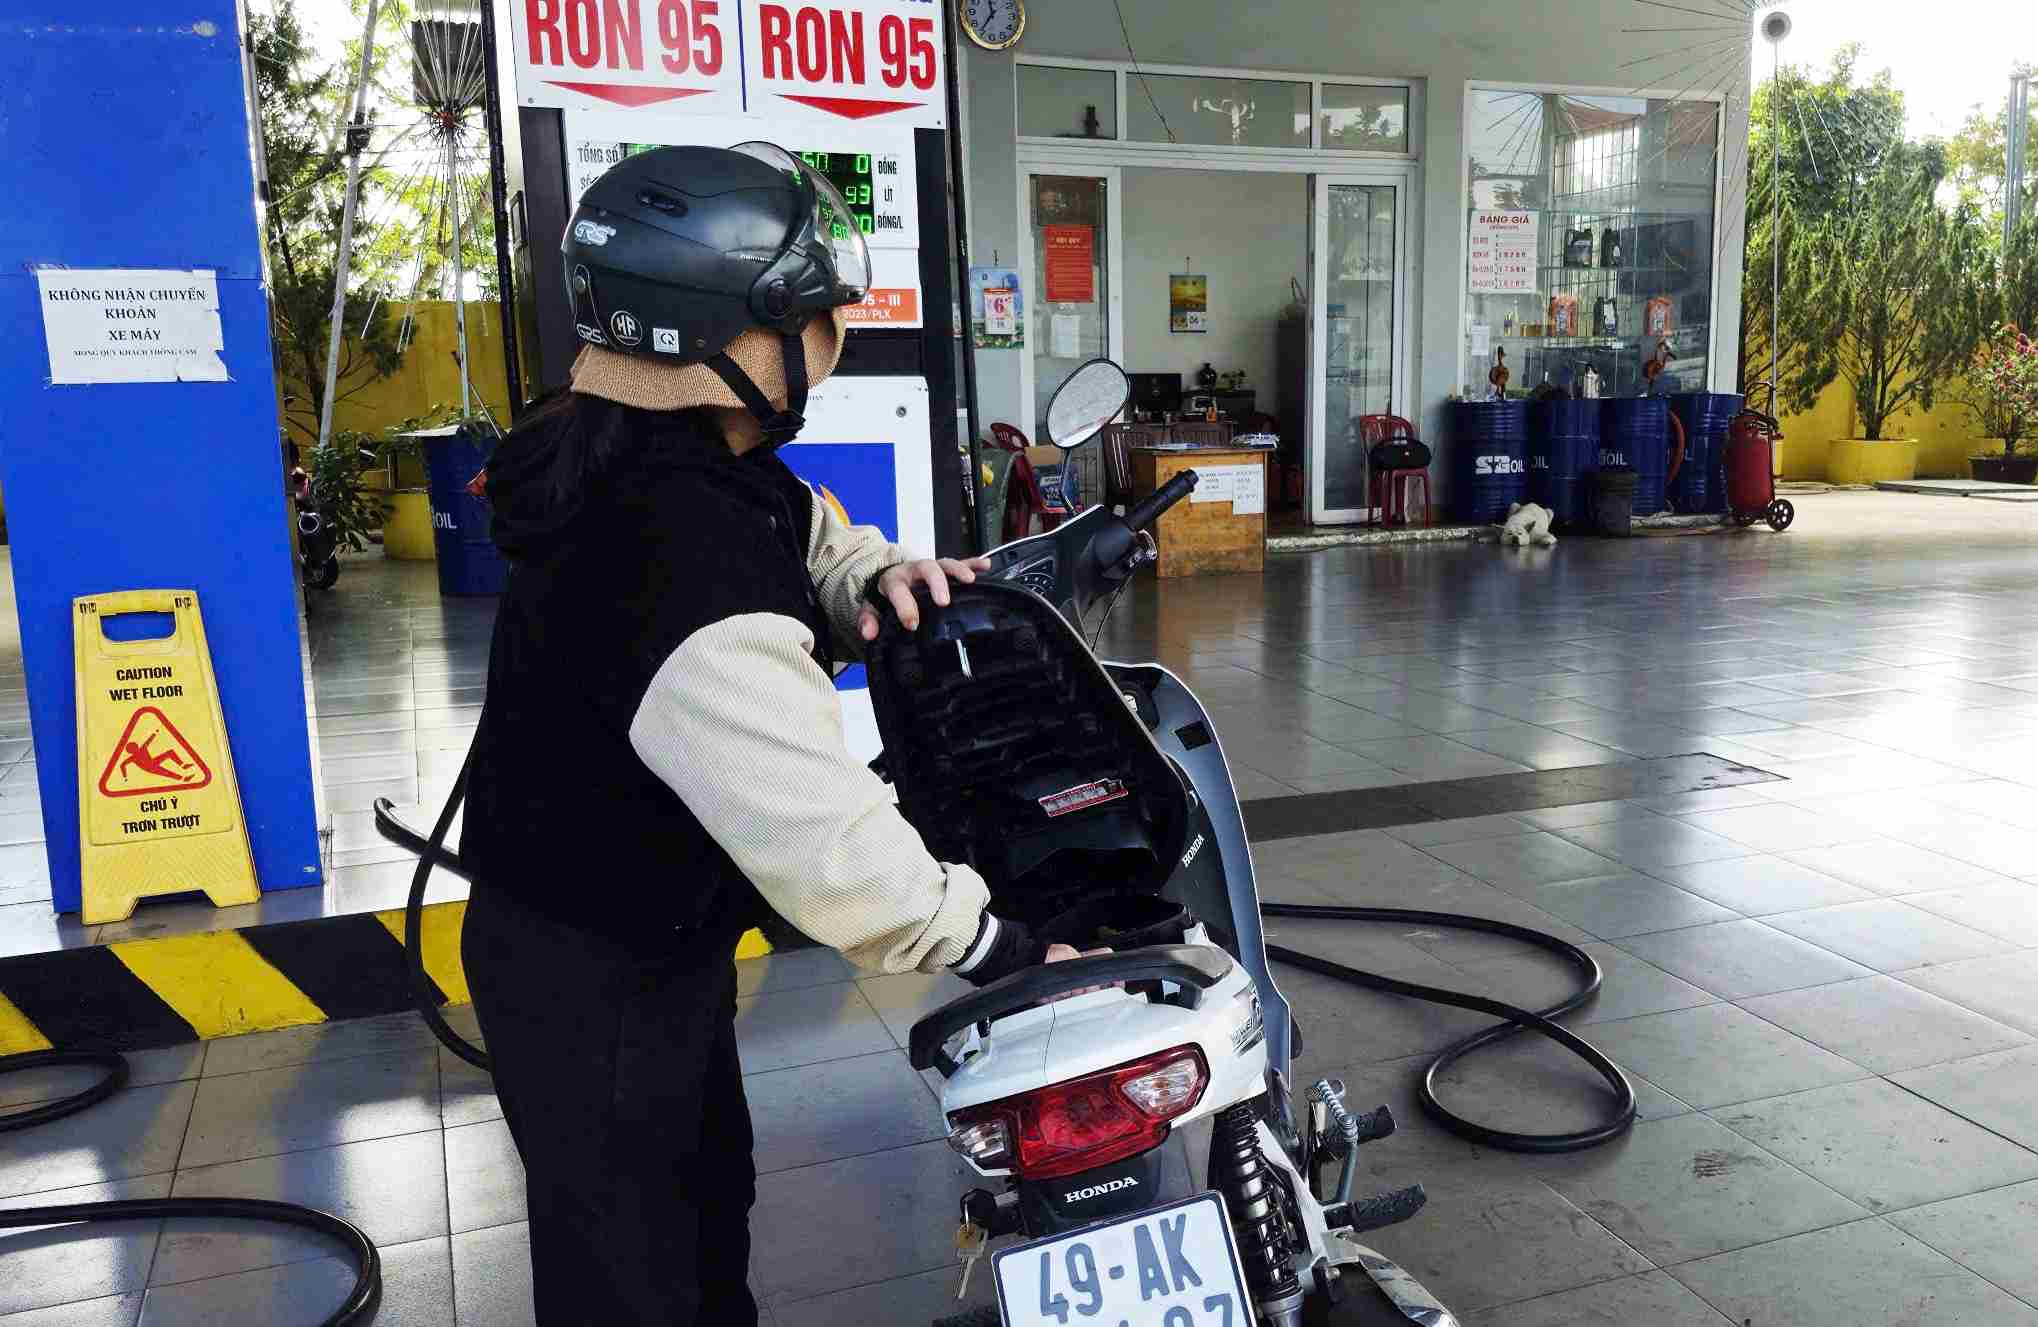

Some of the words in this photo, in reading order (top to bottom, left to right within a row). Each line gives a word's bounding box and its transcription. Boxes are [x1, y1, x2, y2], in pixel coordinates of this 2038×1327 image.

[524, 0, 644, 71] RON
[658, 0, 723, 76] 95
[760, 4, 865, 85] RON
[879, 14, 936, 90] 95
[845, 184, 871, 205] 93
[49, 288, 101, 300] KHÔNG
[105, 288, 146, 303] NHẬN
[109, 329, 127, 341] XE
[131, 328, 162, 341] MÁY
[1510, 458, 1525, 474] OIL
[116, 665, 173, 681] CAUTION
[109, 687, 139, 701] WET
[142, 684, 184, 699] FLOOR
[140, 797, 168, 813] CHÚ
[121, 818, 157, 834] TRƠN
[160, 814, 201, 830] TRƯỢT
[1181, 833, 1206, 869] HONDA
[1064, 1176, 1139, 1203] HONDA
[1040, 1213, 1203, 1324] 49-AK
